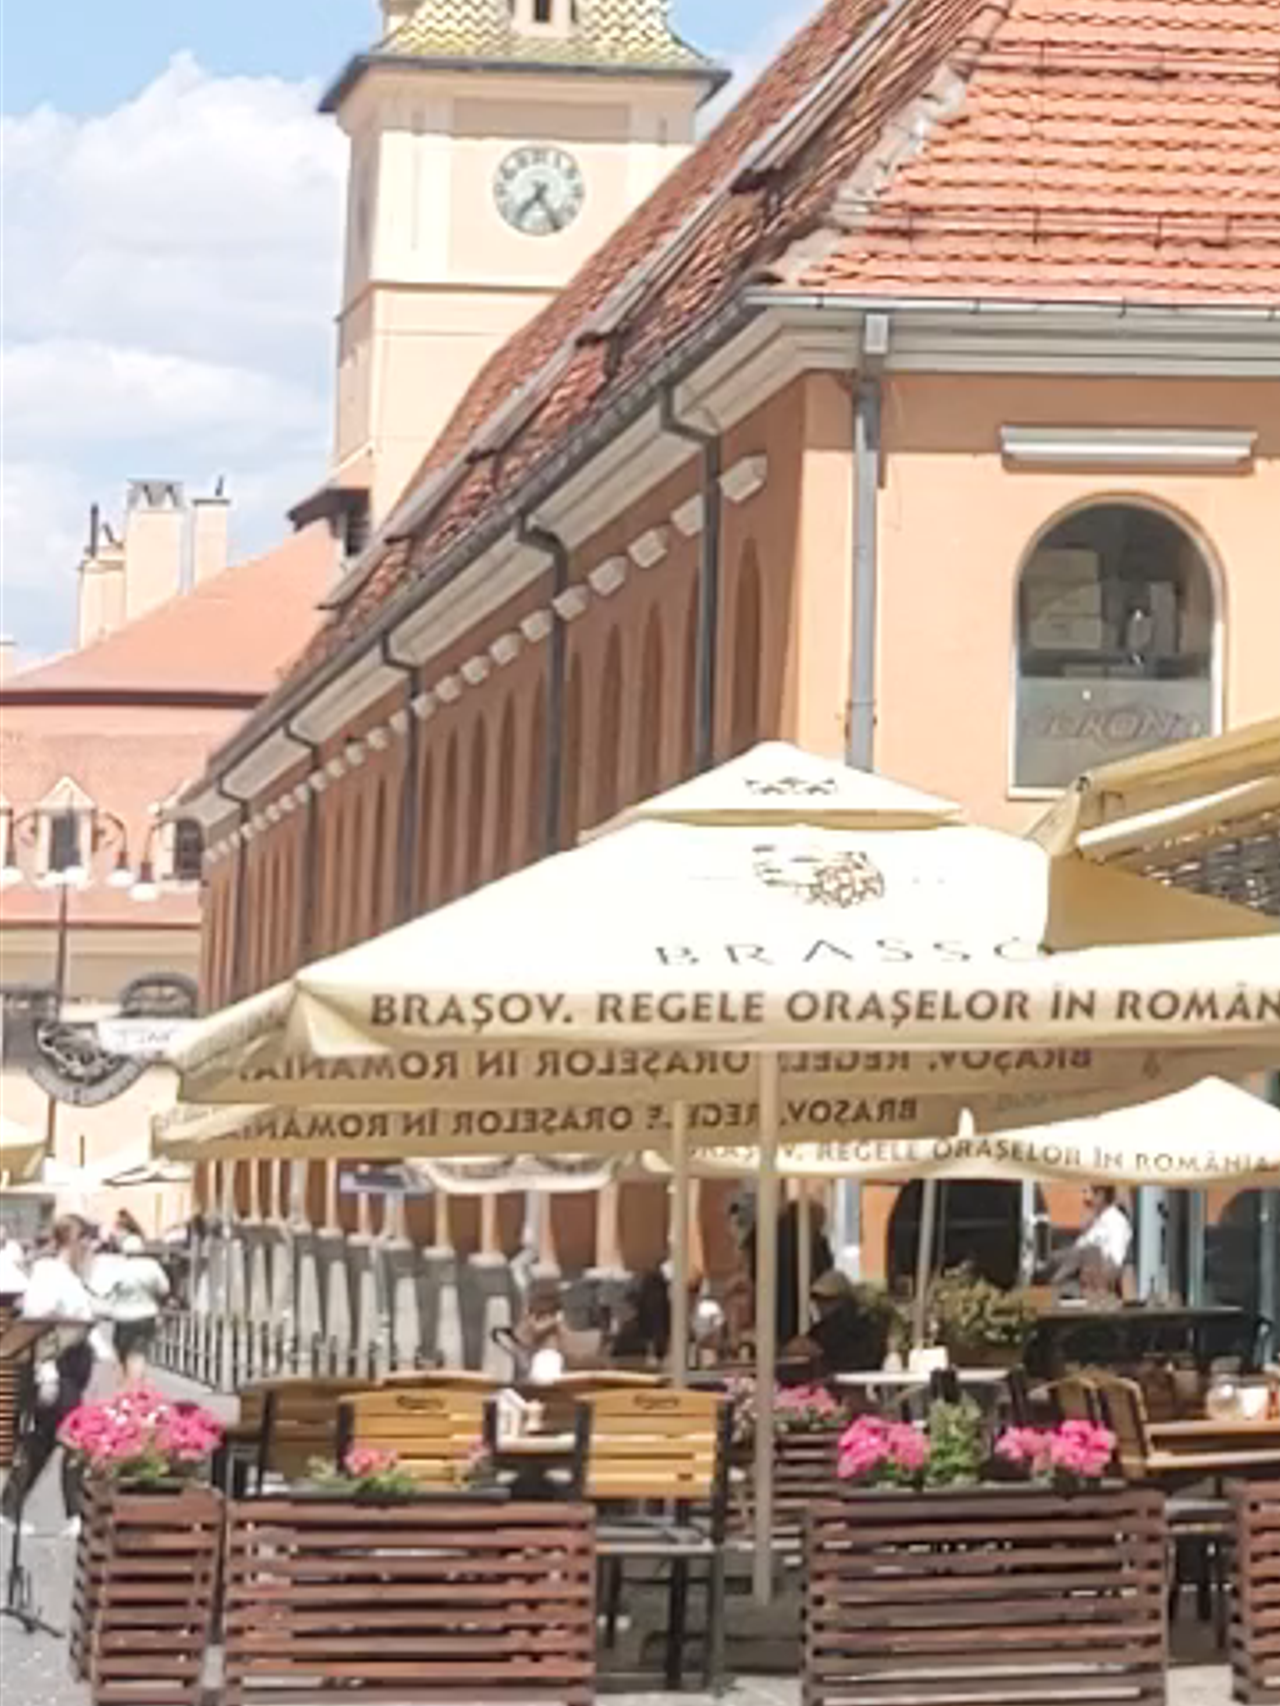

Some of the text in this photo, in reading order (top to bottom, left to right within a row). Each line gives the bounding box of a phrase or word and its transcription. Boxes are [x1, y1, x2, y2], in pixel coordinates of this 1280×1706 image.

[598, 990, 766, 1024] REGELE
[785, 989, 1031, 1029] ORAȘELOR
[1049, 982, 1097, 1021] ÎN
